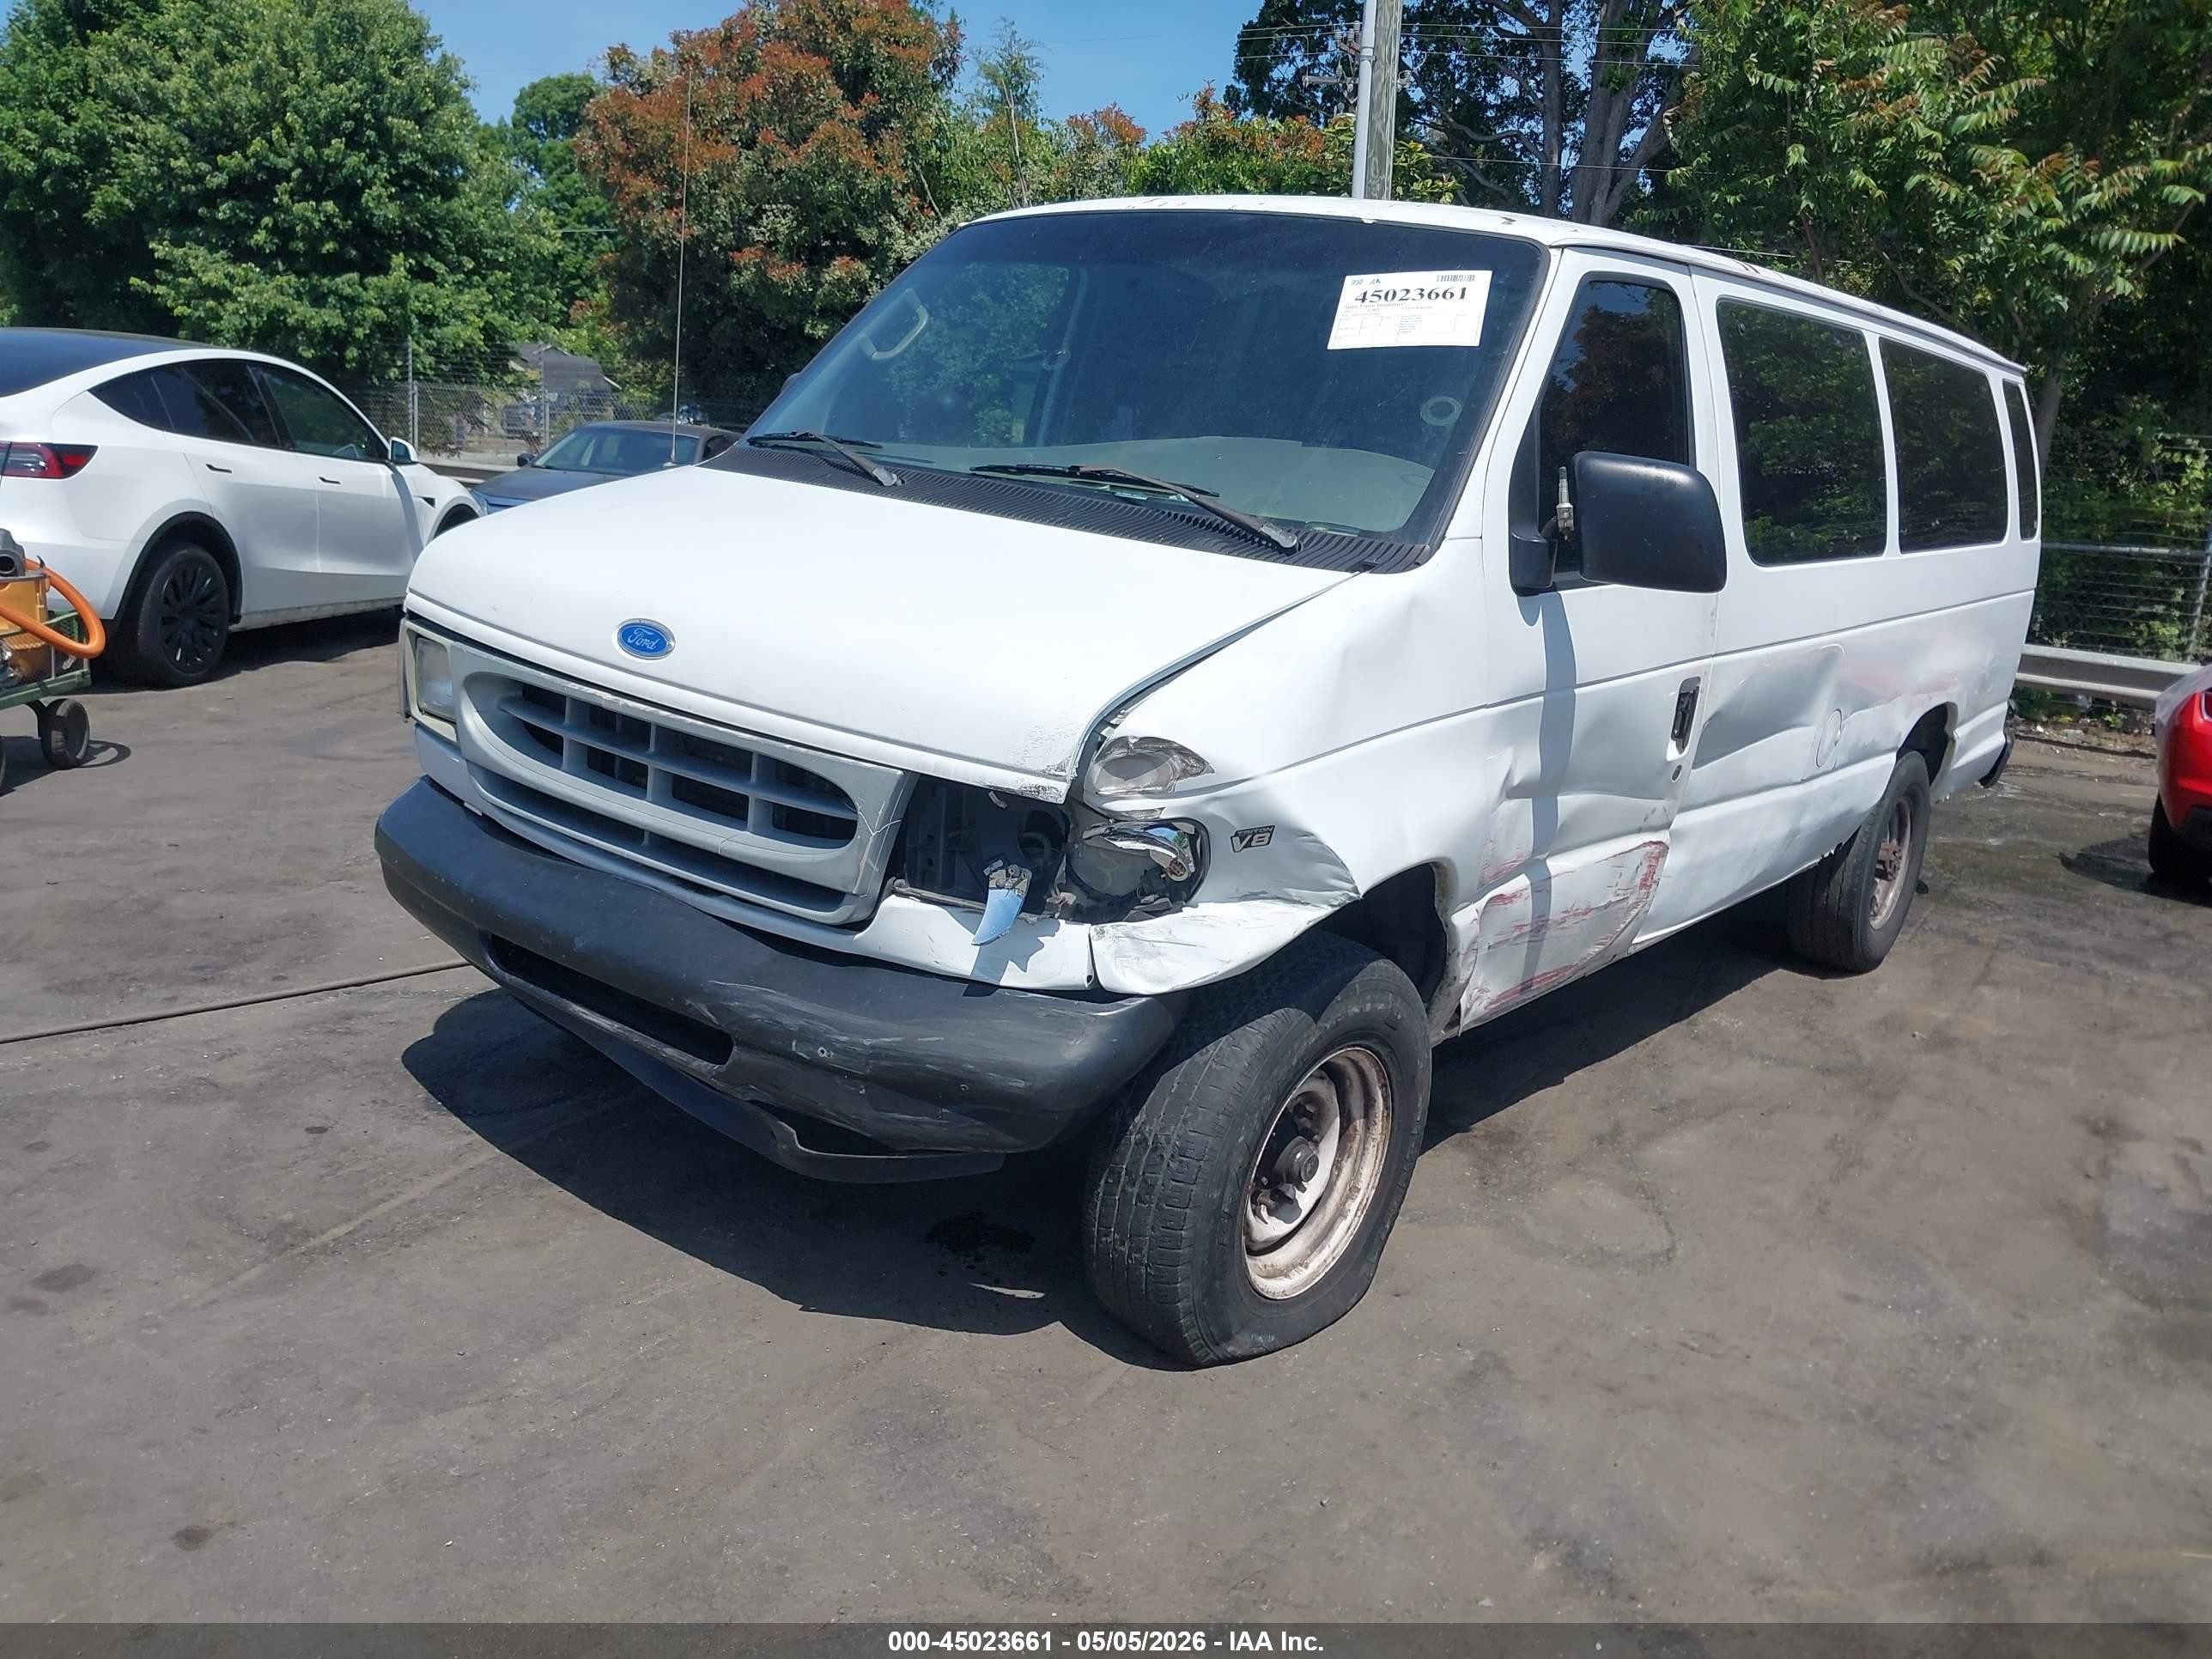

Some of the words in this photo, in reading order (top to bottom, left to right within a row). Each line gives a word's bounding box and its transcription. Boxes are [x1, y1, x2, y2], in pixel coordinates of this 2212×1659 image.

[1354, 287, 1467, 303] 45023661
[627, 628, 660, 650] Ford
[1231, 833, 1271, 852] V8
